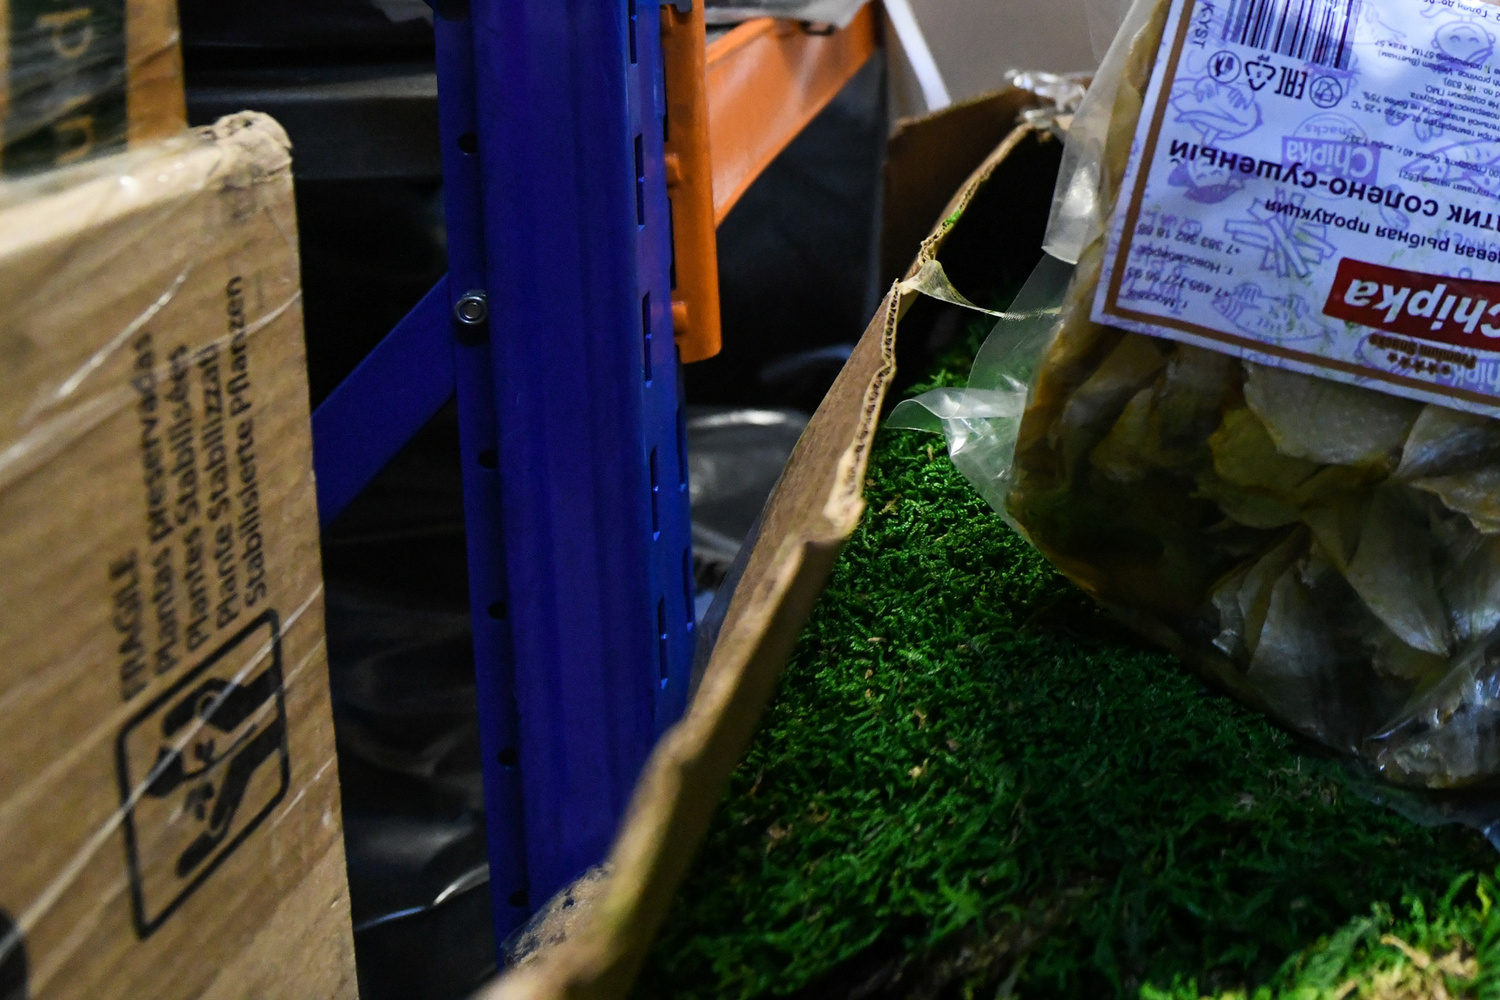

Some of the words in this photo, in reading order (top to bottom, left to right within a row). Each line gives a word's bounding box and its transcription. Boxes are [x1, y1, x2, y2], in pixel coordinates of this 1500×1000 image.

[1453, 66, 1492, 85] province,
[1486, 100, 1499, 110] Не
[1168, 138, 1440, 217] солено-сушеный
[1285, 140, 1375, 179] Chipka
[1263, 198, 1372, 237] продукция
[1375, 222, 1454, 258] рыбная
[227, 275, 251, 418] Pflanzen
[132, 333, 174, 544] preservadas
[234, 417, 267, 606] Stabilisierte
[110, 550, 148, 700] FRAGILE
[152, 545, 178, 675] Plantas
[184, 525, 210, 652] Plantes
[211, 522, 239, 630] Plante
